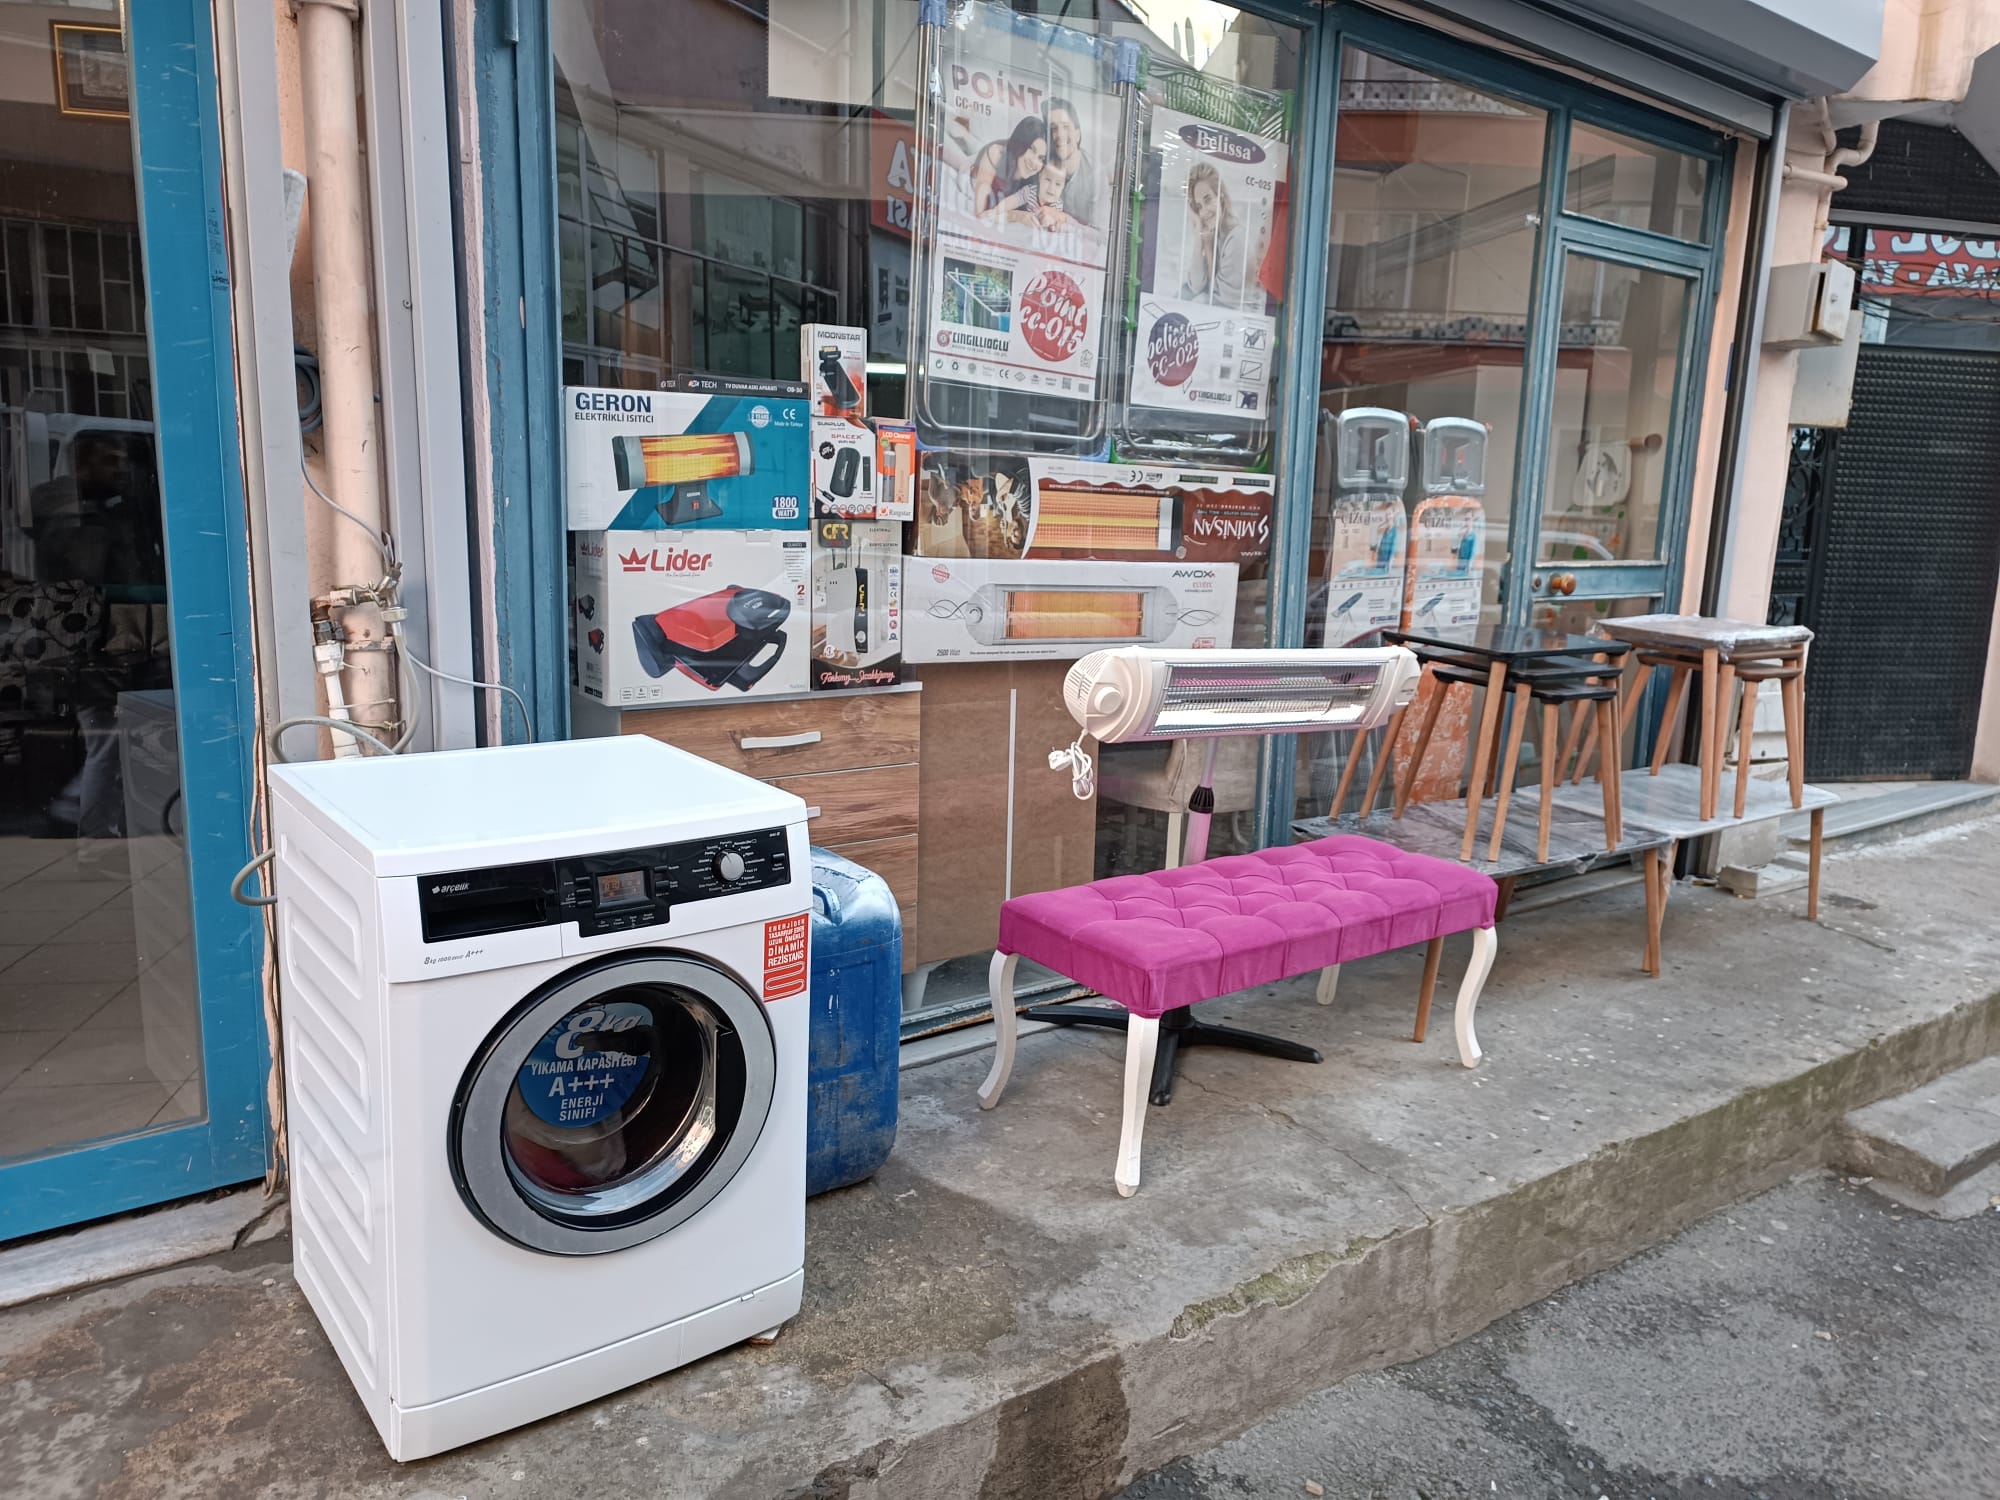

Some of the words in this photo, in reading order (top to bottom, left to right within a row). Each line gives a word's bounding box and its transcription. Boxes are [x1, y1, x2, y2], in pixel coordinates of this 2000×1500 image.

[817, 330, 861, 340] MOONSTAR
[701, 380, 718, 389] TECH
[575, 391, 651, 413] GERON
[574, 411, 625, 422] ELEKTRİKLİ
[626, 414, 654, 423] ISITICI
[774, 496, 797, 508] 1800
[777, 509, 793, 517] WATT
[650, 546, 711, 571] Lider
[1172, 570, 1214, 578] AWOX
[797, 584, 805, 595] 2
[440, 882, 470, 893] arçelik
[768, 937, 783, 946] UZUN
[465, 949, 483, 958] A+++
[768, 939, 805, 957] DİNAMİK
[768, 950, 804, 968] REZİSTANS
[531, 1057, 574, 1076] YIKAMA
[548, 1073, 615, 1097] A+++
[561, 1093, 604, 1110] ENERJİ
[559, 1107, 596, 1121] SINIFI
